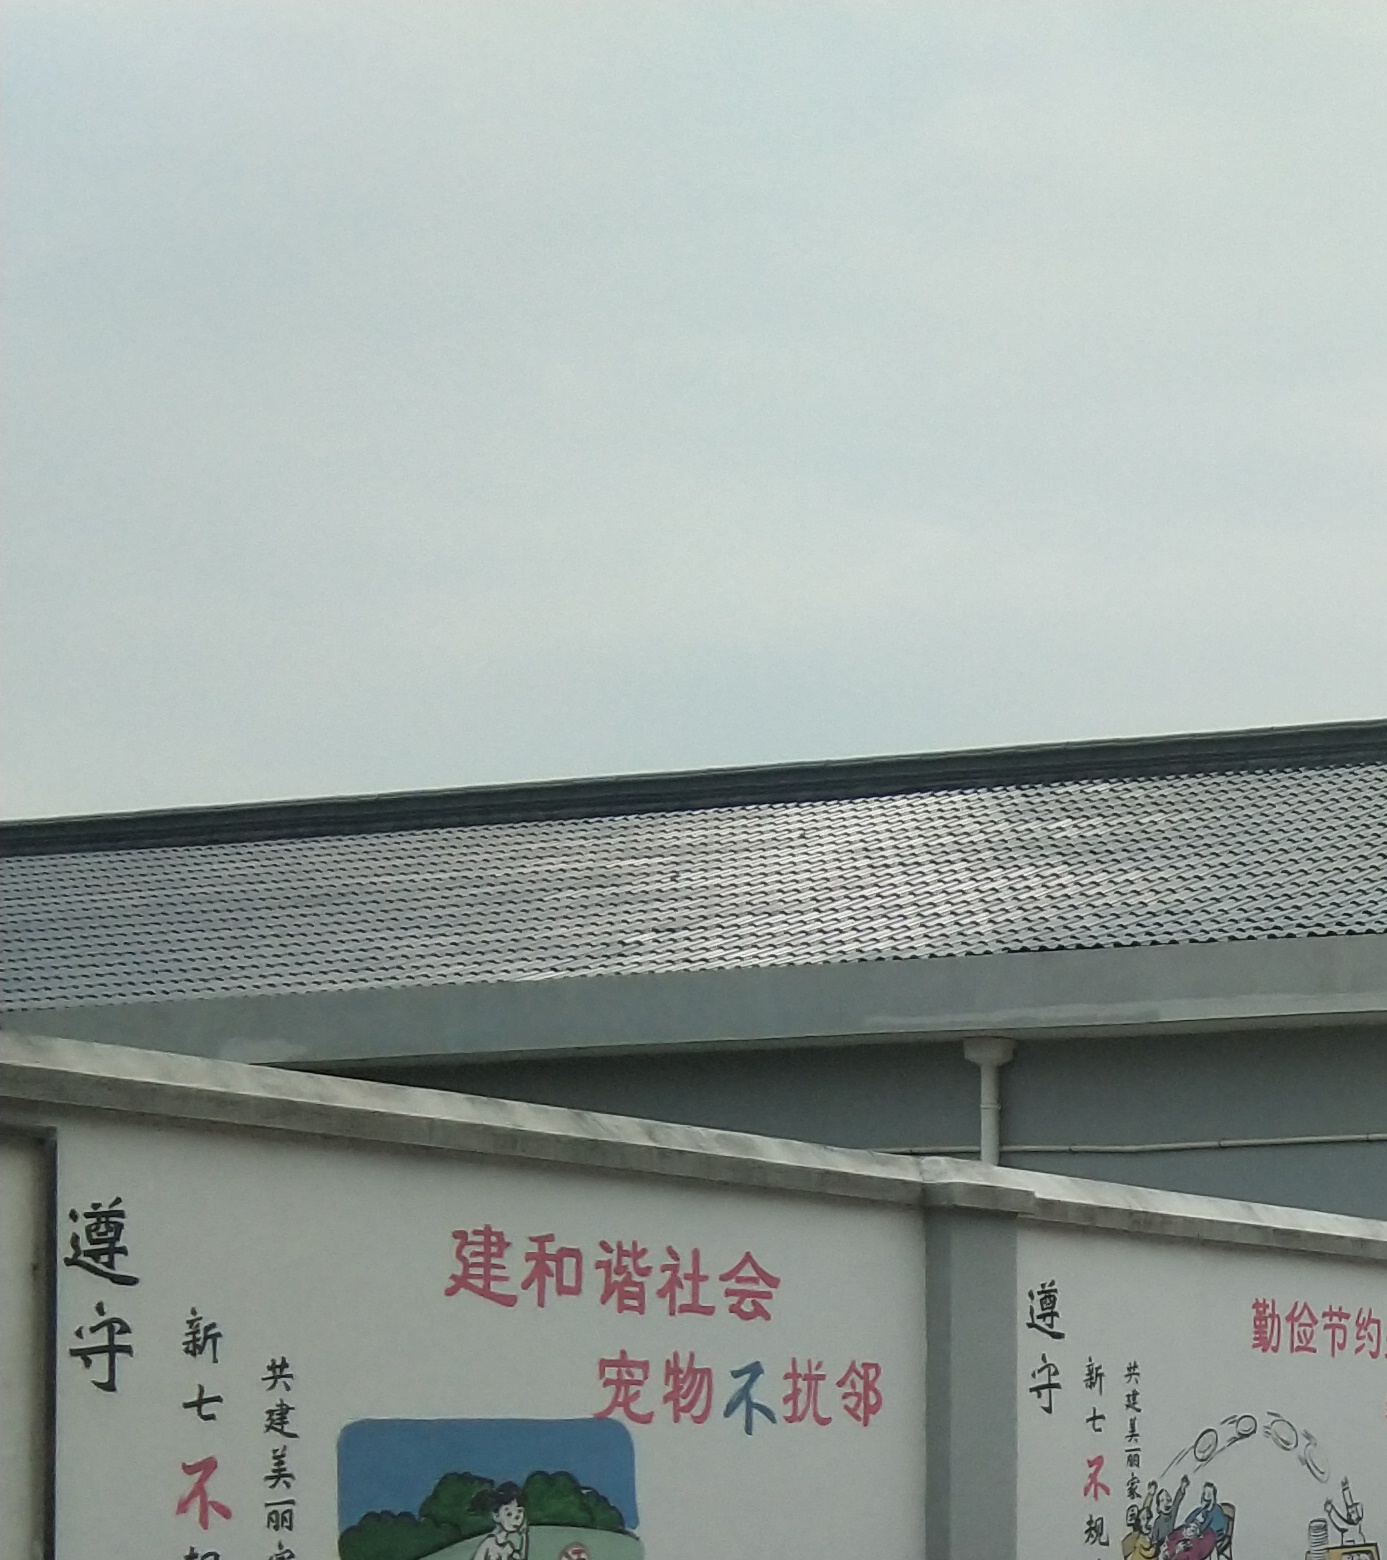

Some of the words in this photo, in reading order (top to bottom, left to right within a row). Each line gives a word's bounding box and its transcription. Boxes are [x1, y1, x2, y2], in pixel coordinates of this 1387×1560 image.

[64, 1197, 139, 1392] 遵守
[444, 1224, 781, 1321] 建和谐社会
[594, 1349, 883, 1436] 宠物不扰邻
[1026, 1280, 1065, 1413] 遵守
